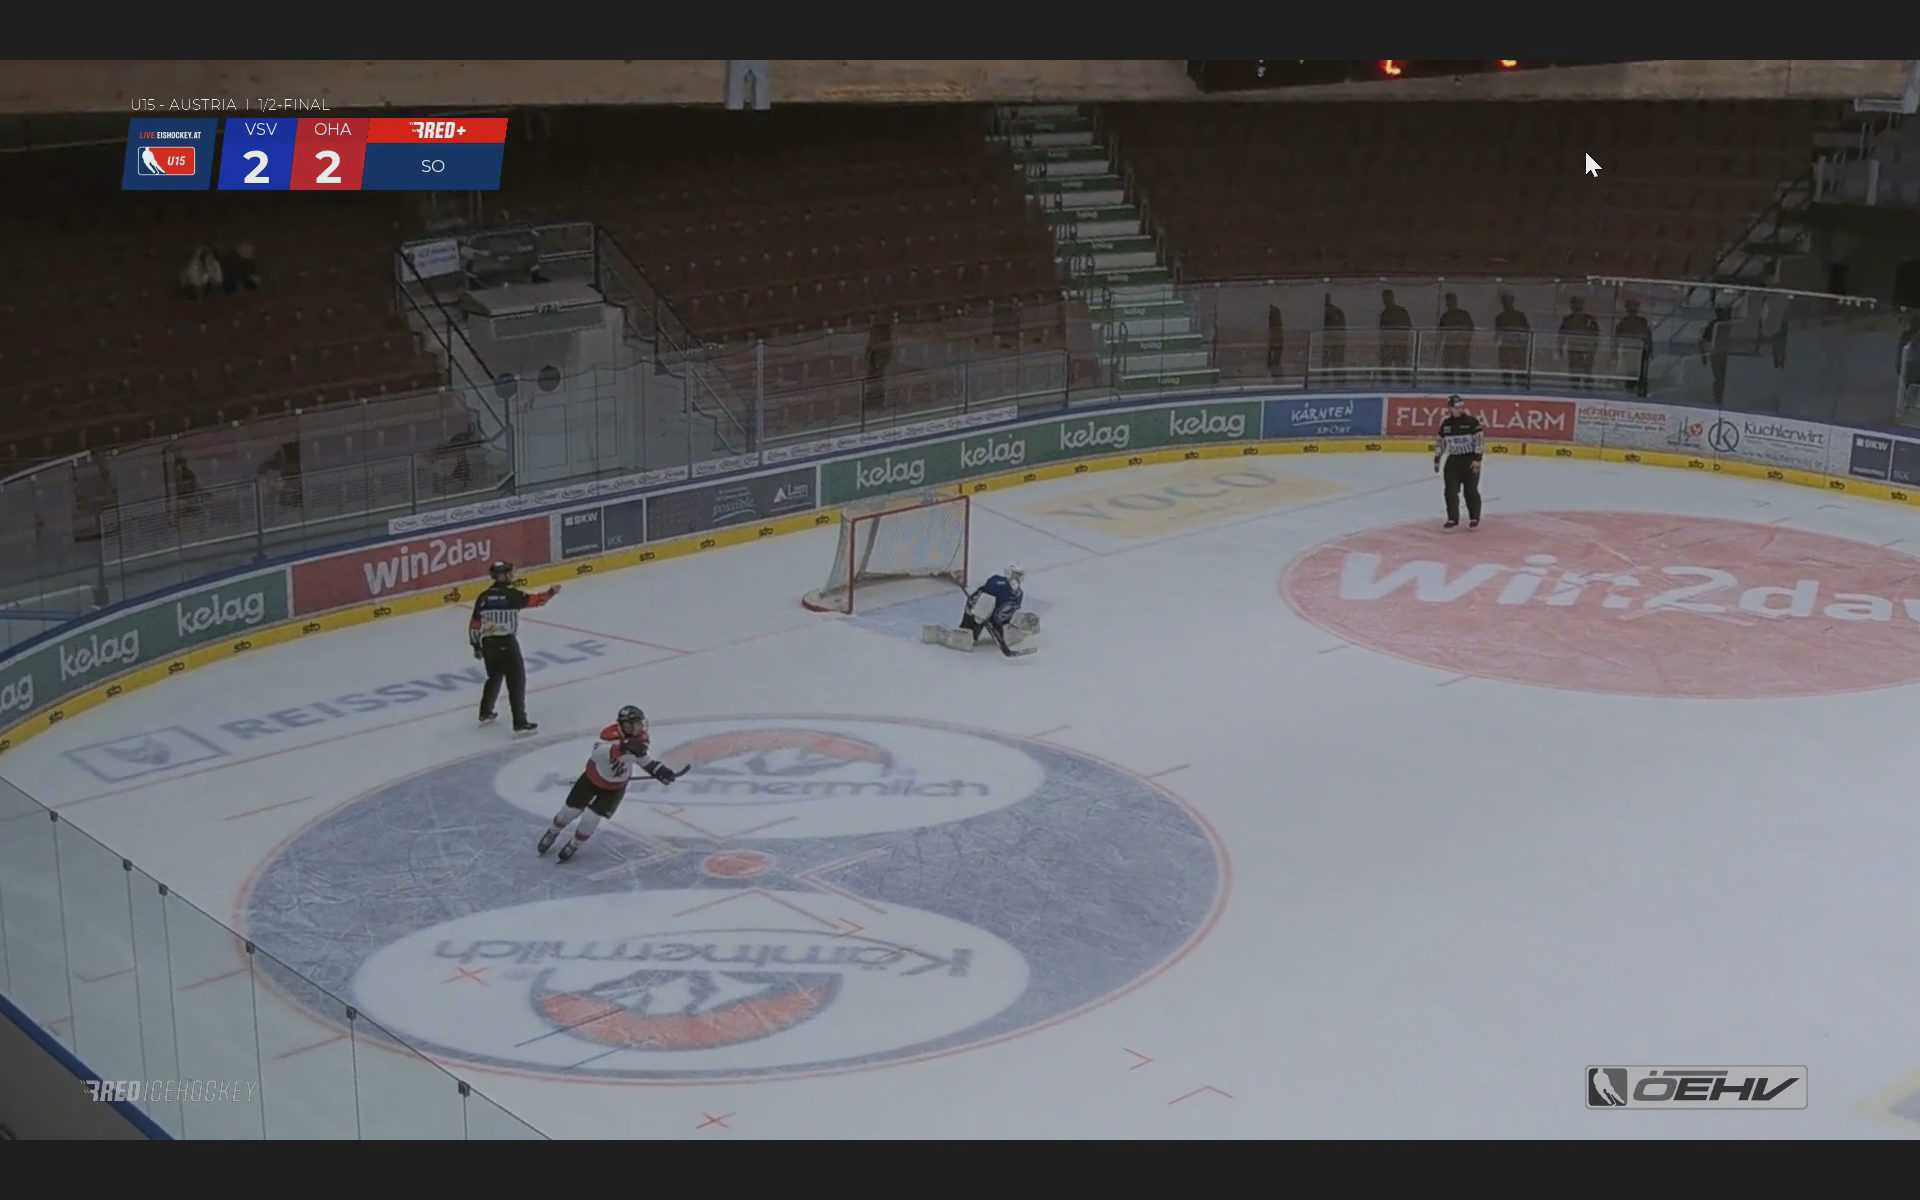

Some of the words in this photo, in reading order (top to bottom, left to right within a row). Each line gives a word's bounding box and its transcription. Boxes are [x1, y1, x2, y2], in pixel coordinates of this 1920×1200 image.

[1059, 421, 1130, 450] kelag
[1169, 410, 1246, 438] kelag
[959, 437, 1026, 469] kelag
[855, 457, 925, 490] kelag
[363, 537, 492, 596] win2day
[1337, 551, 1920, 621] win2da
[176, 591, 265, 638] kelag
[59, 629, 140, 682] kelag
[0, 673, 34, 711] ag
